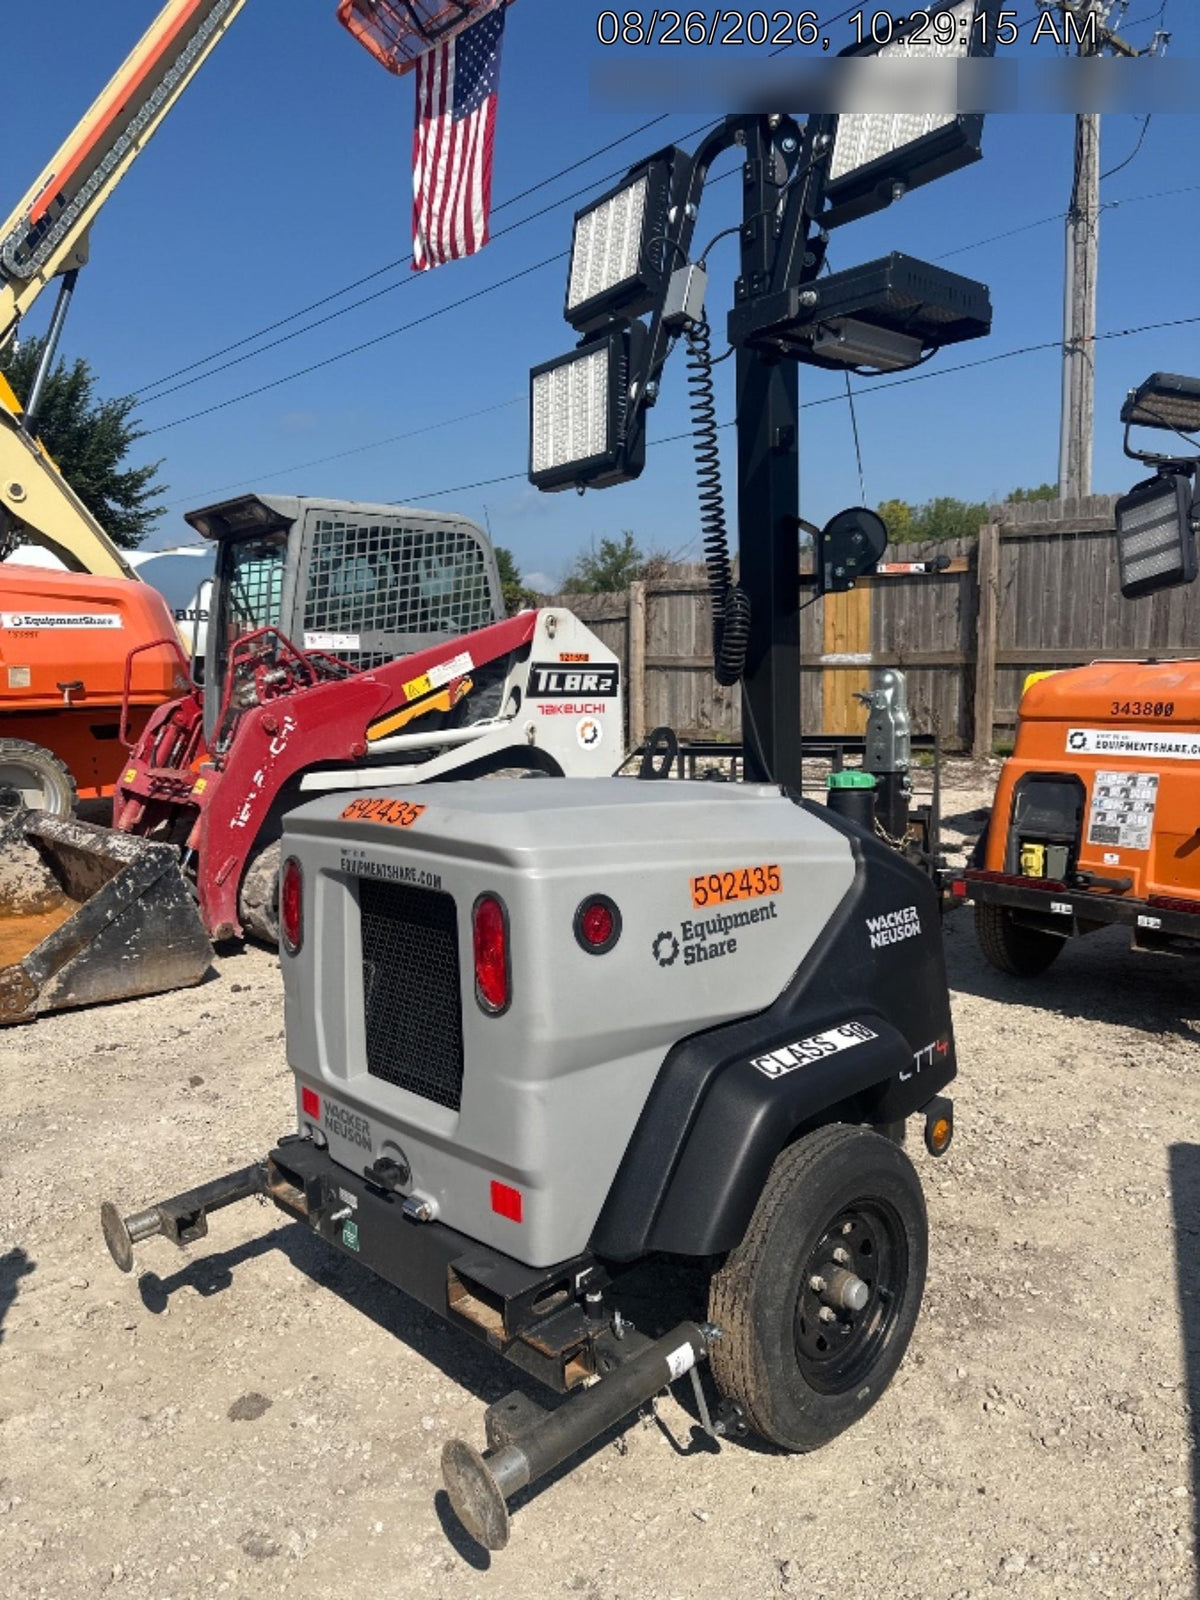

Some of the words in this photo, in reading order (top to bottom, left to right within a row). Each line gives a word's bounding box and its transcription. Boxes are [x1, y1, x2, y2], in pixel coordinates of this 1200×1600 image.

[24, 616, 113, 626] EquipmentShare
[535, 669, 615, 692] TL8R2
[1110, 702, 1175, 717] 343800
[342, 798, 426, 826] 592435
[340, 858, 442, 889] EQUIPMENTSHARE.COM
[694, 864, 780, 905] 592435
[681, 901, 778, 941] Equipment
[865, 906, 919, 933] WACKER
[869, 921, 922, 949] NEUSON
[684, 938, 737, 966] Share
[754, 1036, 838, 1075] CLASS
[323, 1100, 371, 1136] WACKER
[324, 1114, 372, 1152] NEUSON
